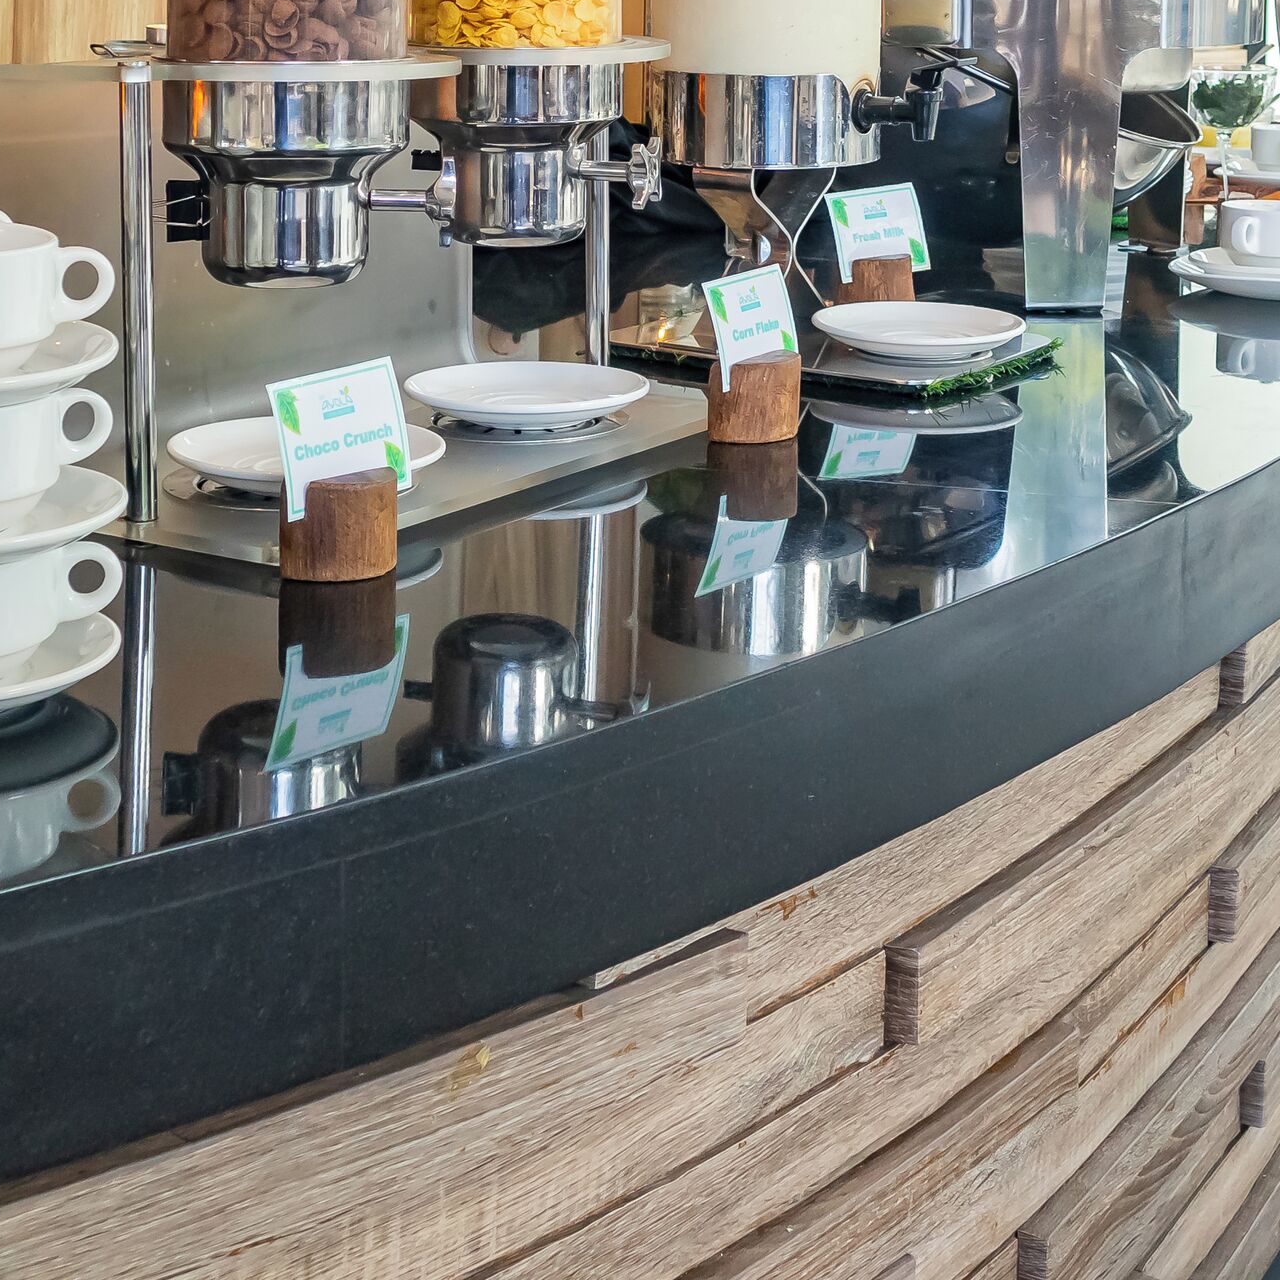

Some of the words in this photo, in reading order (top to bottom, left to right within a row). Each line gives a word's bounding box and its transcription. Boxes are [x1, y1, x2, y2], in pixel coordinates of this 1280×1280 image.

[732, 328, 754, 341] Corn
[294, 440, 340, 461] Choco
[343, 423, 393, 447] Crunch
